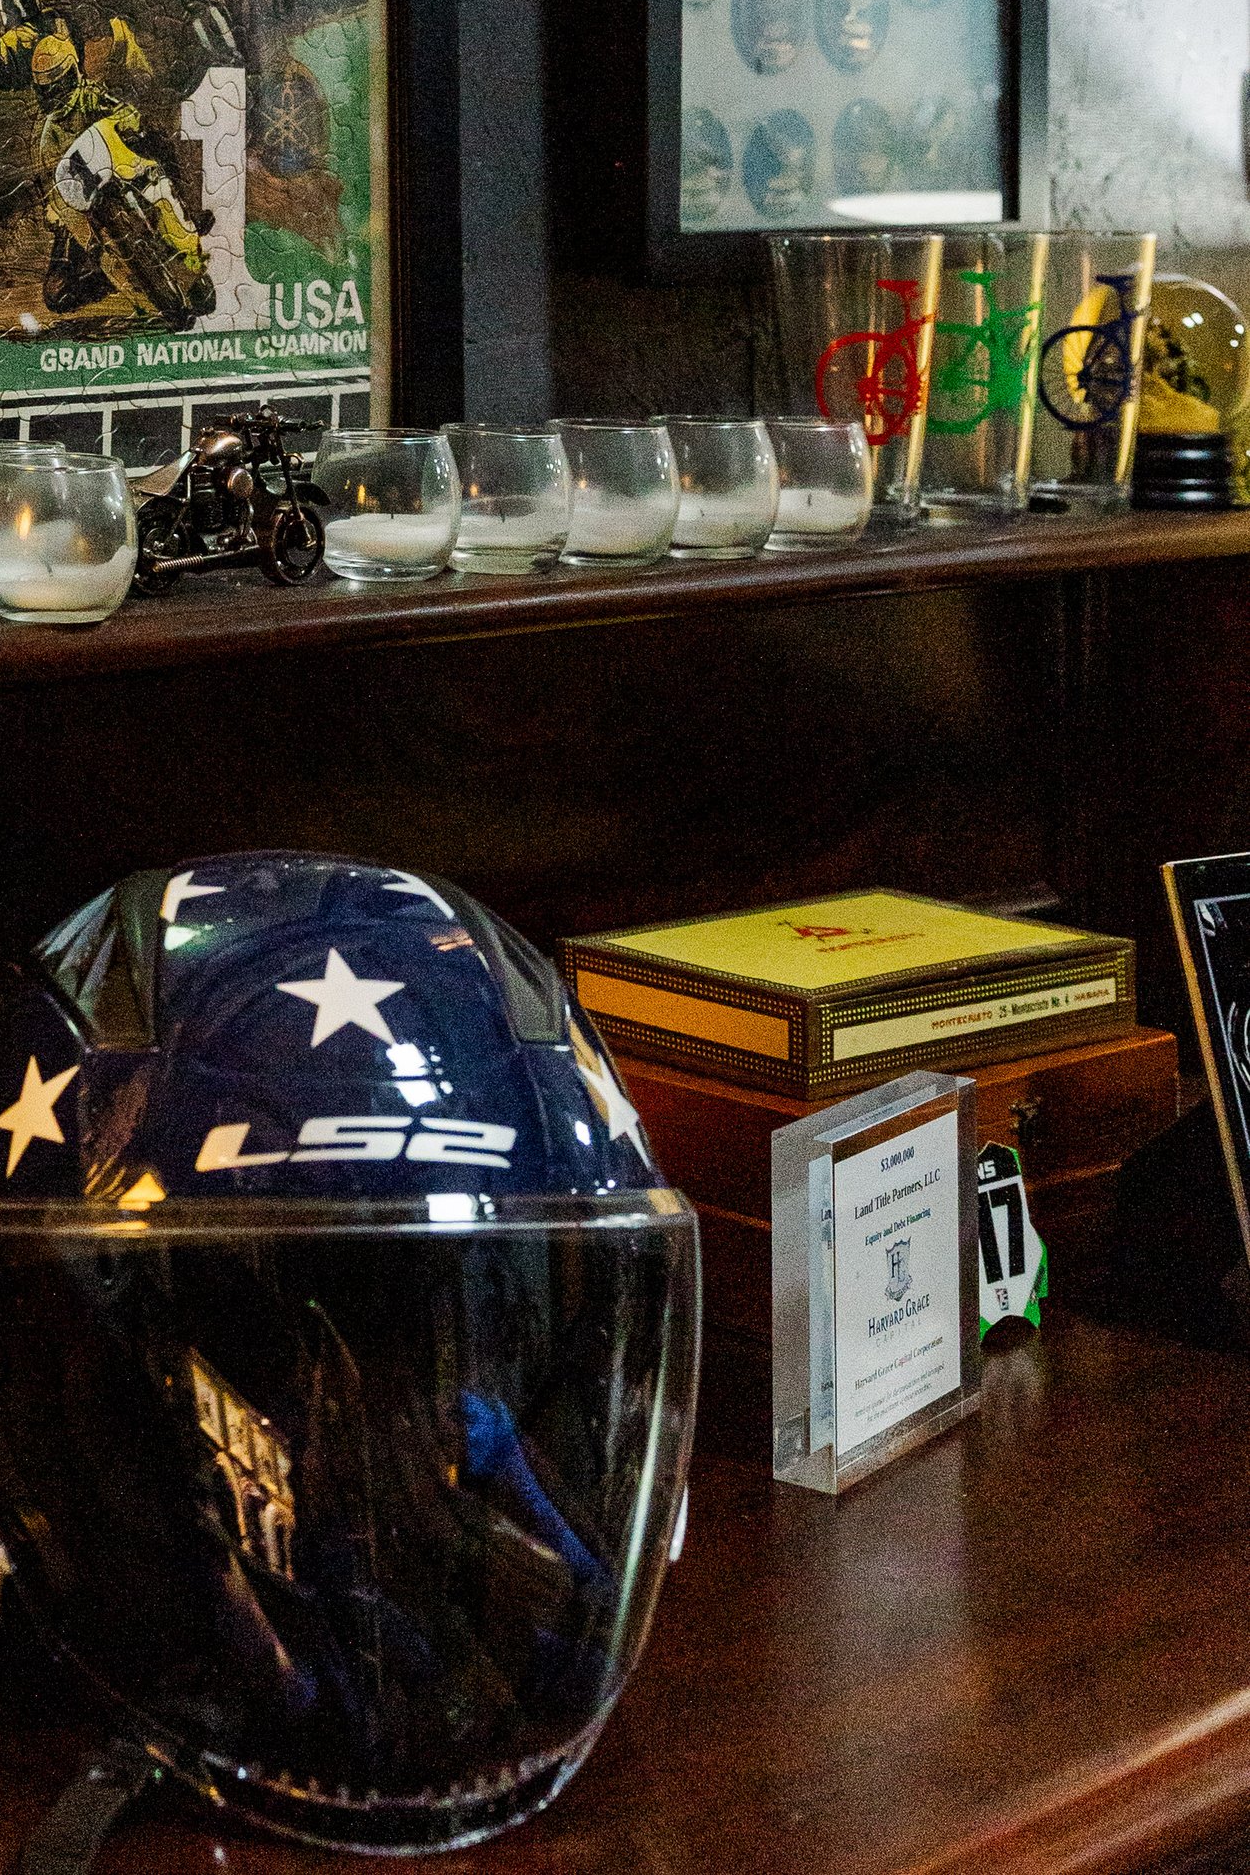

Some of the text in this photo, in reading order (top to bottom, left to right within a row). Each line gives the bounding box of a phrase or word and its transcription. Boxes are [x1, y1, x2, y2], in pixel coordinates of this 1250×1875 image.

[274, 280, 365, 330] USA
[39, 329, 367, 373] GRAND NATIONAL CHAMPION
[195, 1115, 518, 1173] LS2
[854, 1200, 874, 1220] Land
[875, 1192, 891, 1211] Title
[924, 1168, 941, 1188] LLC
